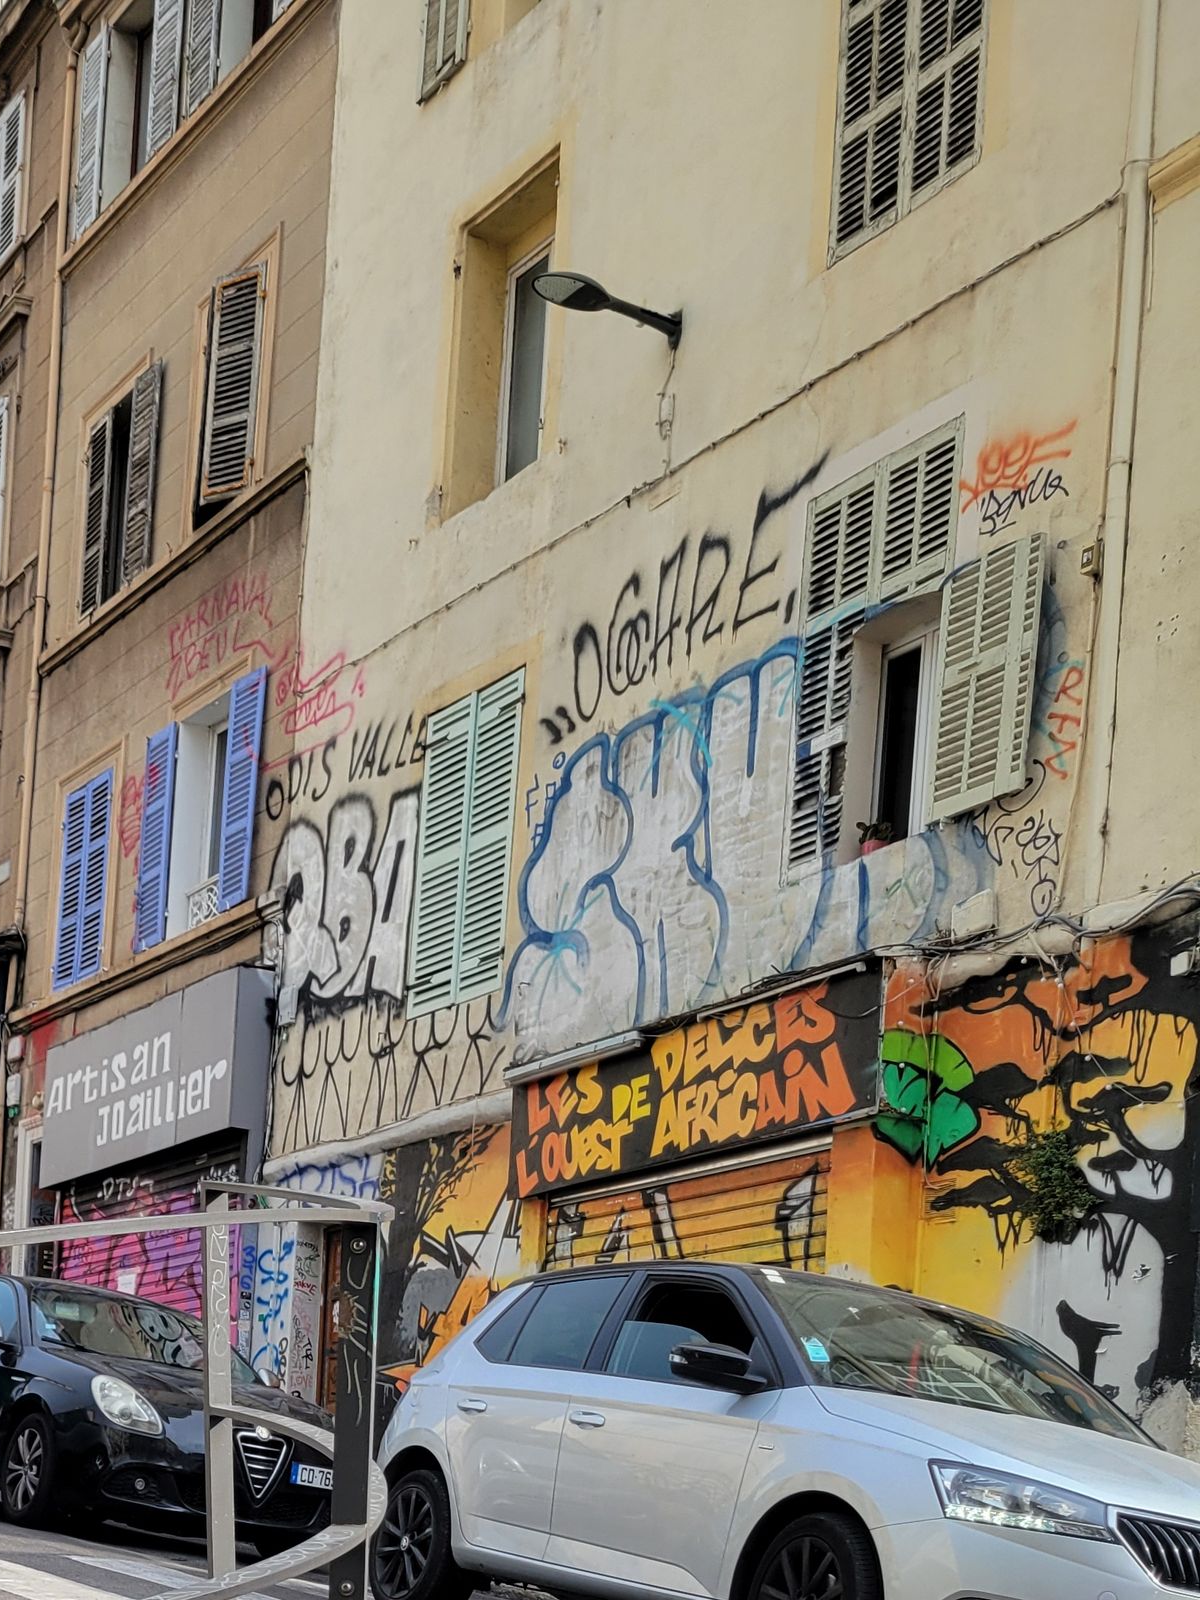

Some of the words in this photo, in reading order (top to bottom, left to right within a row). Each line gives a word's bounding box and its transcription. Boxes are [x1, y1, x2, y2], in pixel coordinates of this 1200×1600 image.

[46, 1031, 172, 1118] Artisan
[527, 1061, 603, 1136] LES
[611, 1073, 652, 1125] DE
[300, 1467, 334, 1488] CD-76
